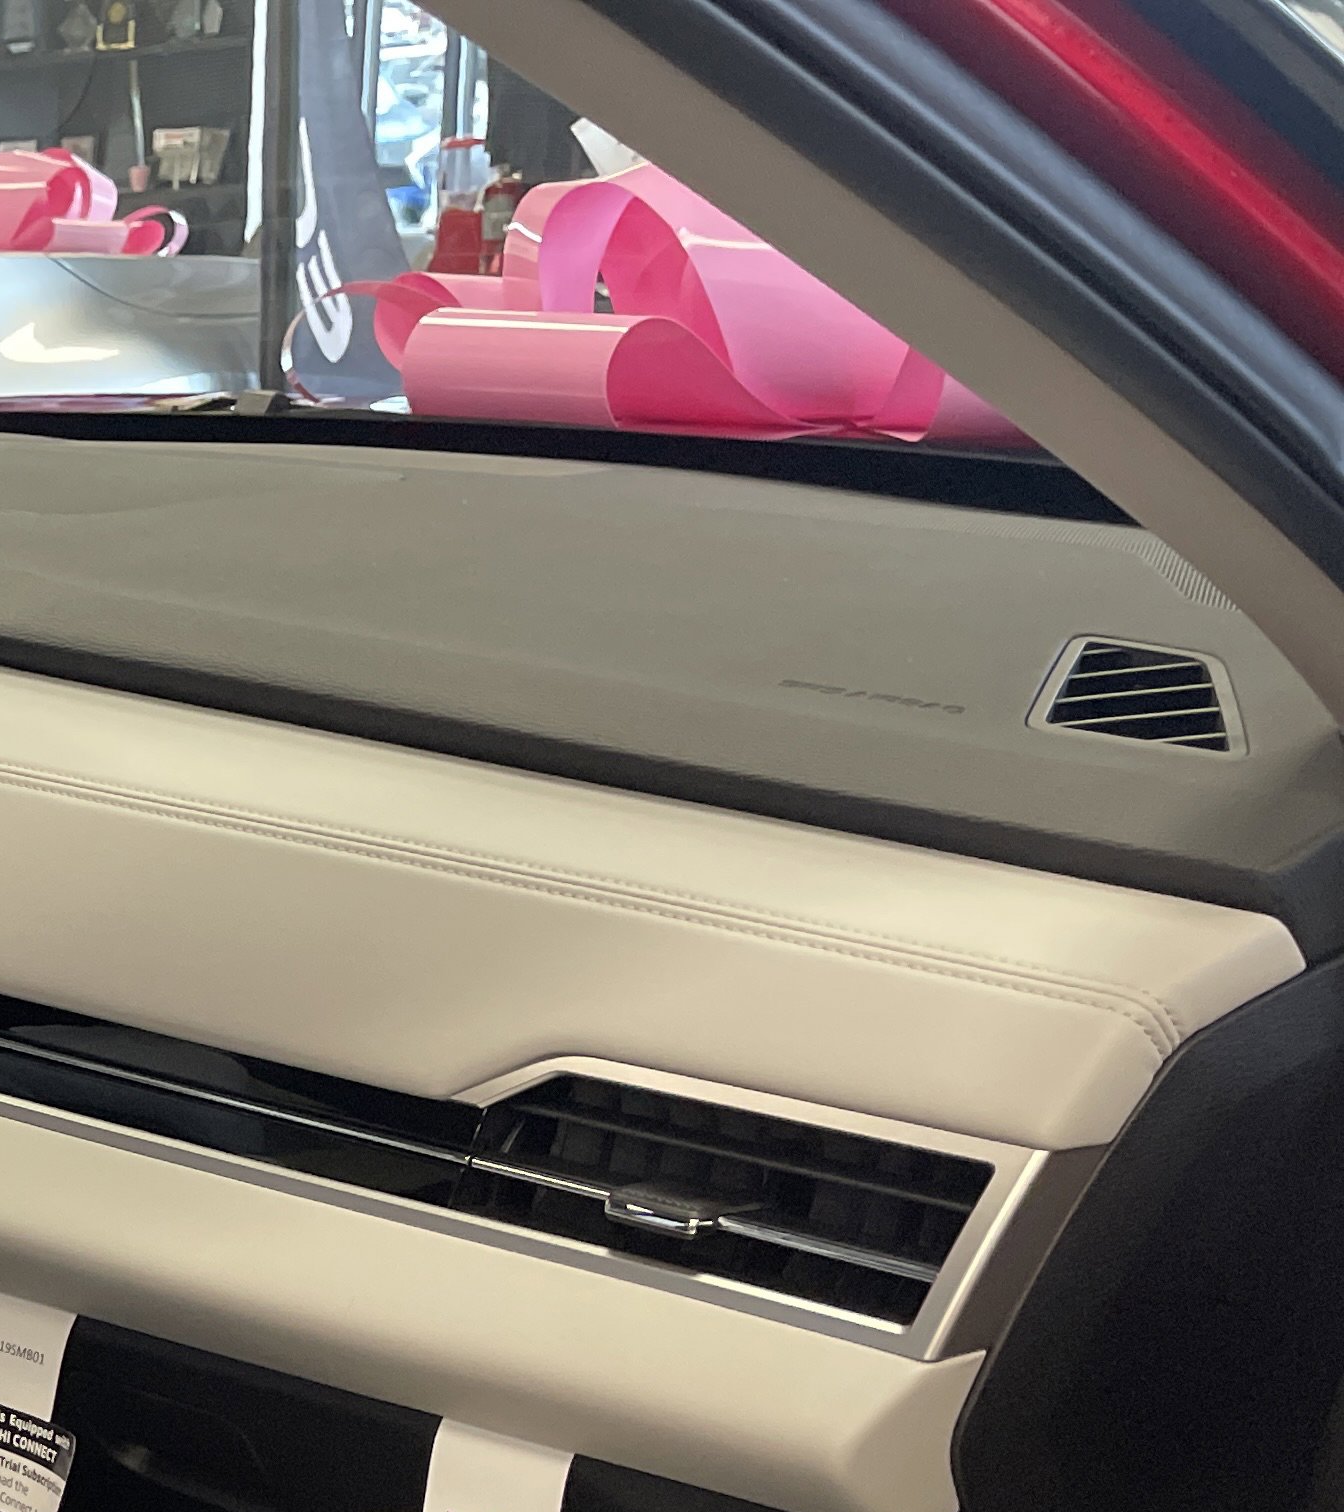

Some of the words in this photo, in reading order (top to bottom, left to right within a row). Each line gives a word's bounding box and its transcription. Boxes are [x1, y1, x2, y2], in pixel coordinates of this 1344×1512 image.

[9, 1413, 54, 1441] Equipped
[12, 1433, 58, 1464] CONNECT
[0, 1455, 21, 1473] Trial
[14, 1480, 29, 1496] the
